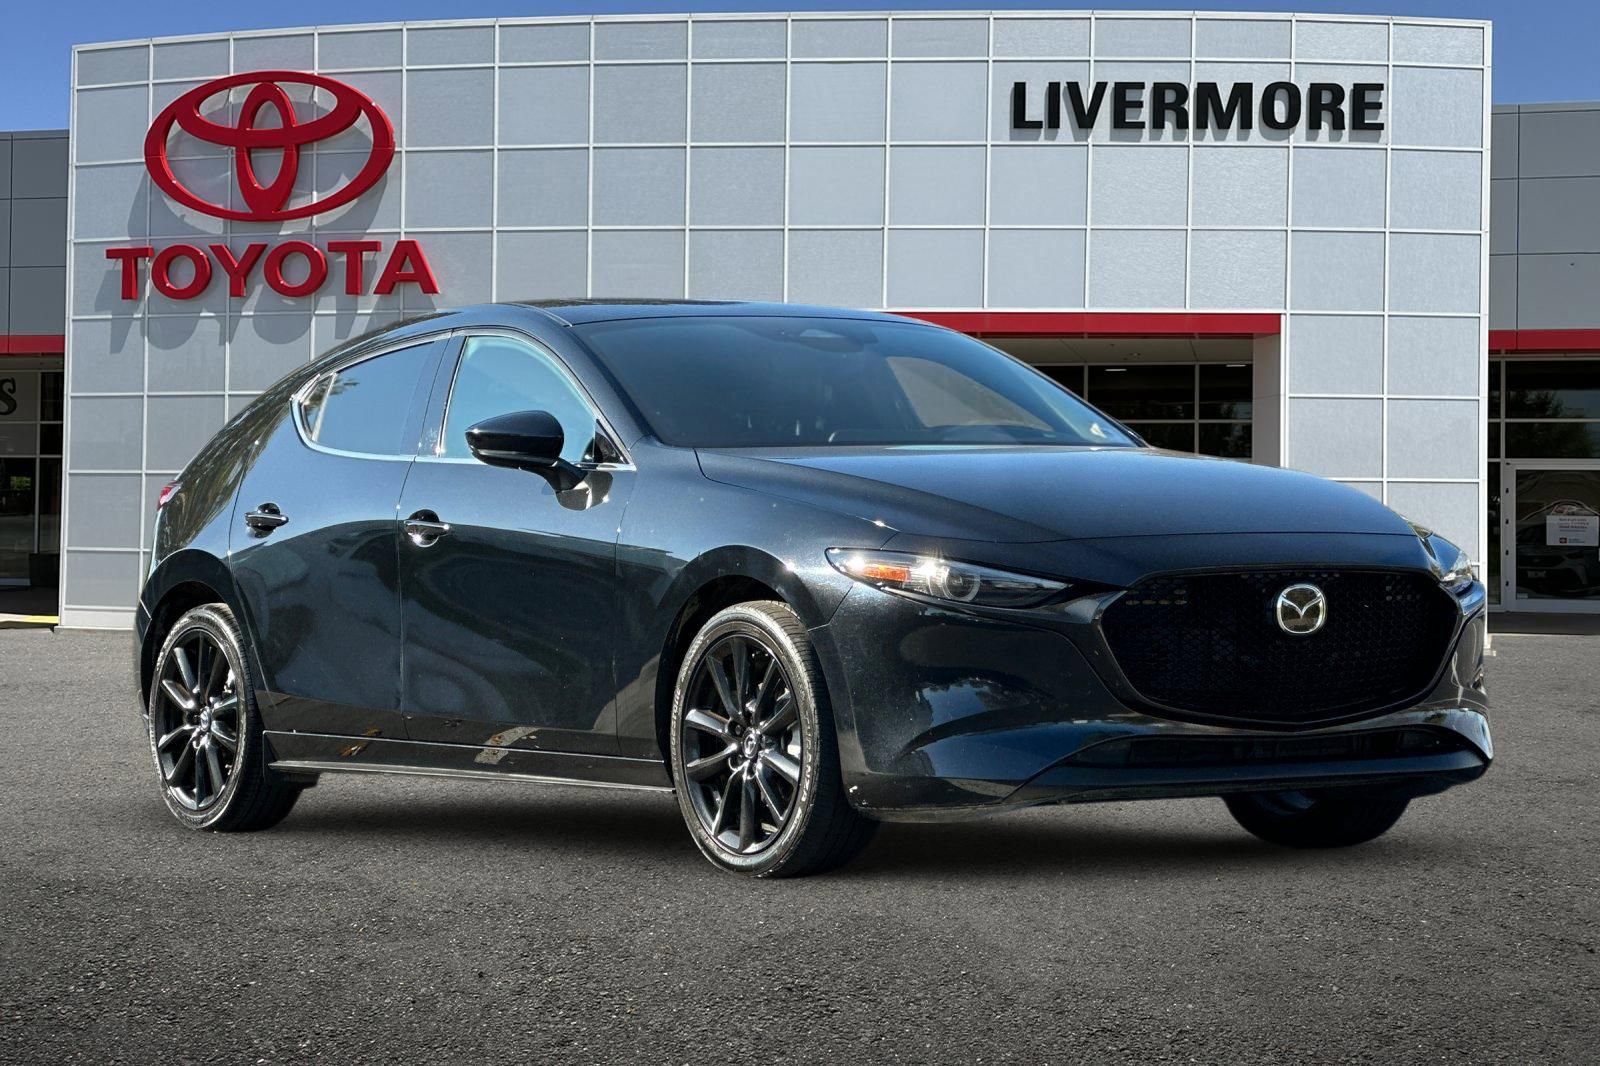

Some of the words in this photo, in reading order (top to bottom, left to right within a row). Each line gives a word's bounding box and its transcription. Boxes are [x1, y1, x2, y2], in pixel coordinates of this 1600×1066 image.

[1012, 81, 1385, 131] LIVERMORE
[106, 240, 440, 300] TOYOTA
[800, 710, 812, 802] TURANZA
